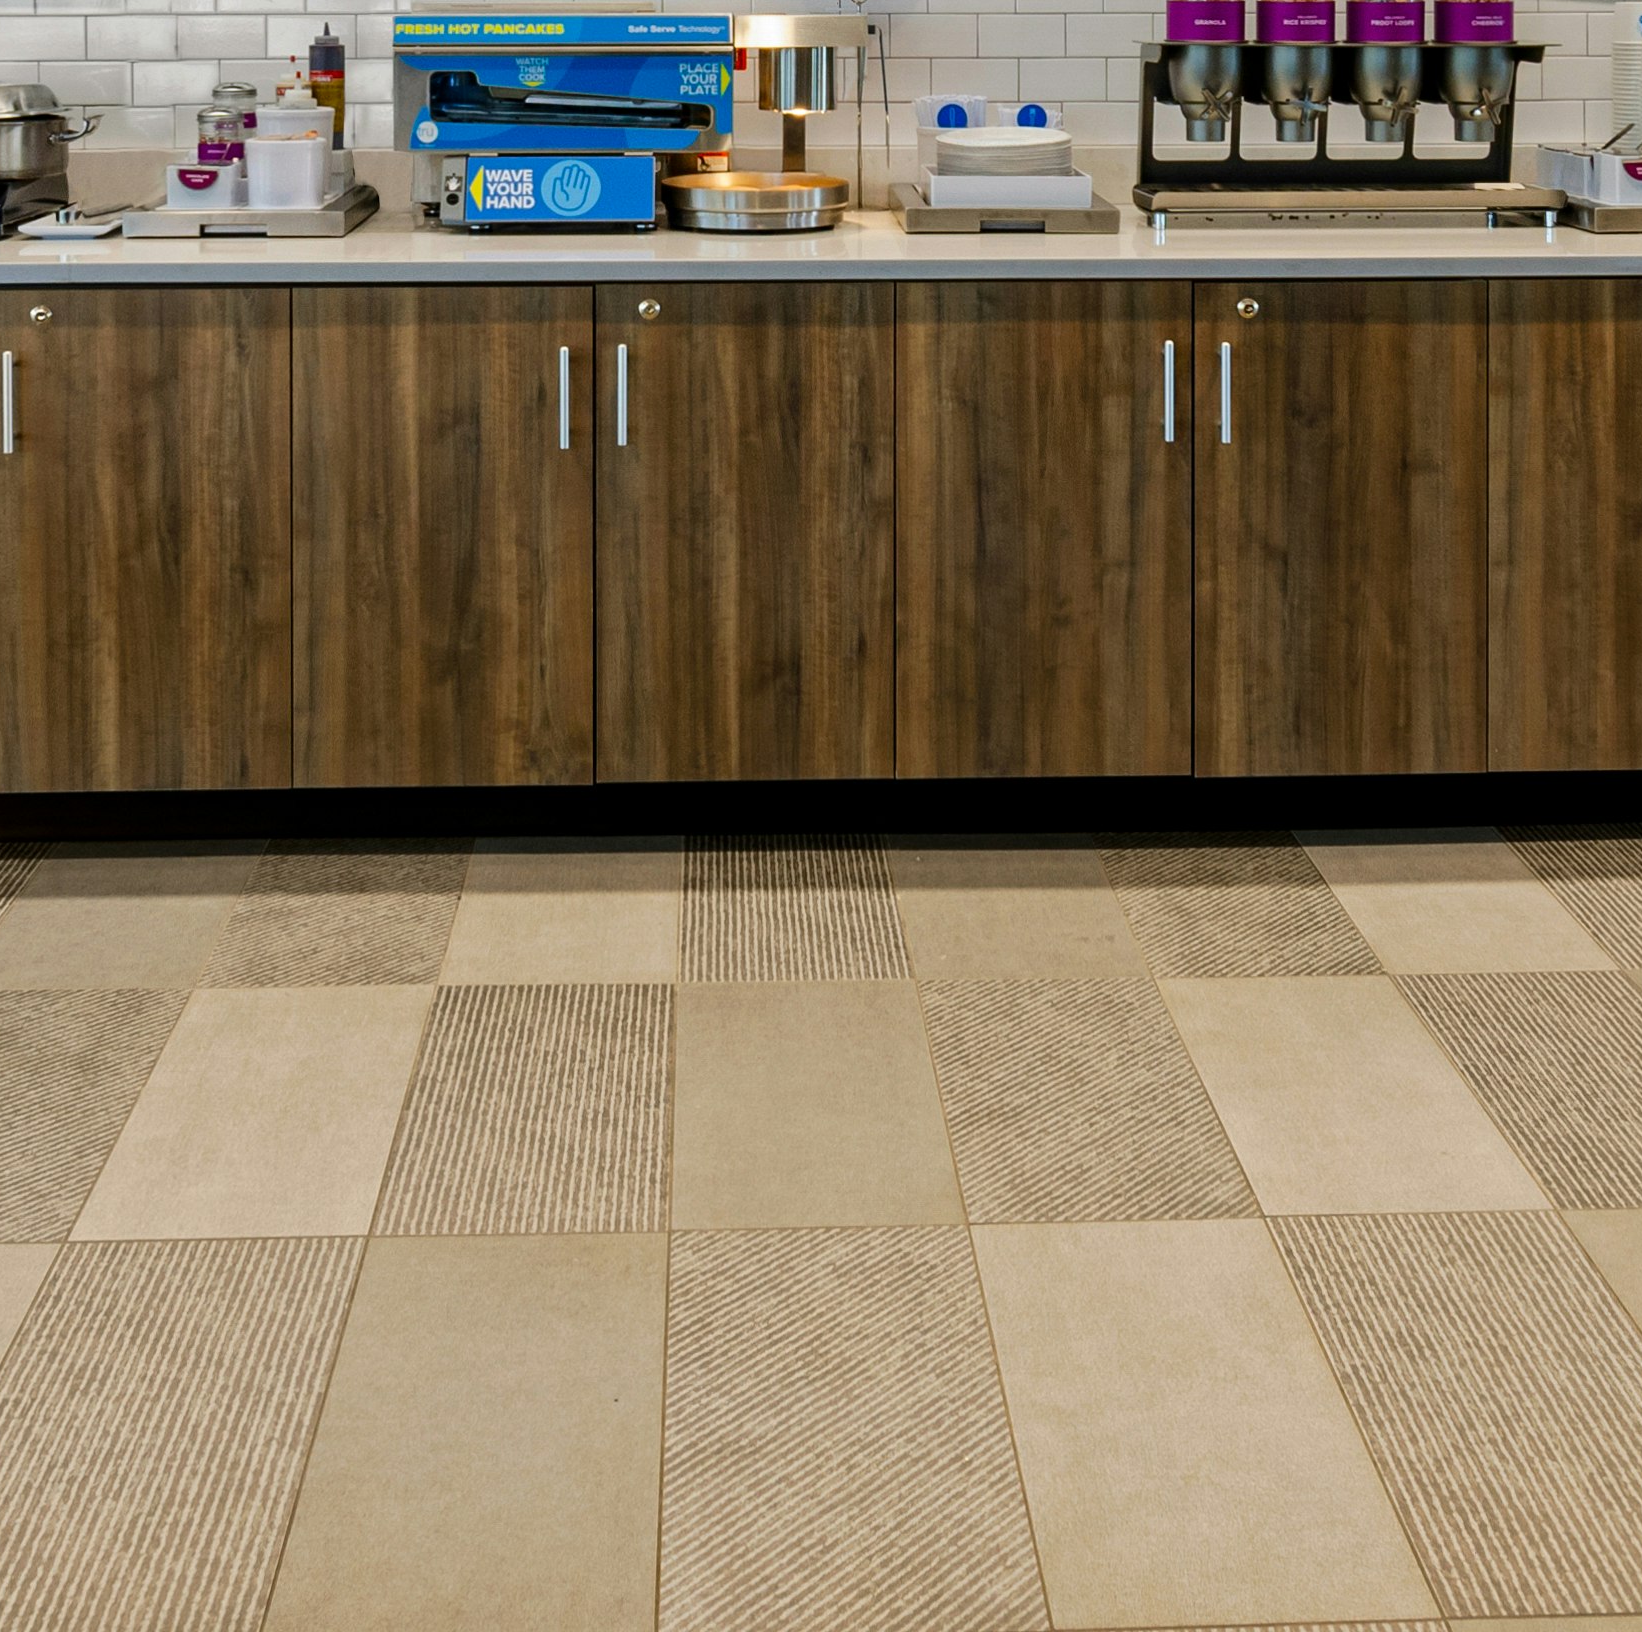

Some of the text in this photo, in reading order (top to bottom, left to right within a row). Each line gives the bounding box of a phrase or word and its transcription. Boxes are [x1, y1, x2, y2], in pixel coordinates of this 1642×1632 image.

[394, 23, 565, 35] FRESH HOT PANCAKES
[627, 25, 648, 33] Safe
[650, 25, 676, 33] Serve
[515, 57, 549, 66] WATCH
[679, 63, 718, 73] PLACE
[681, 74, 717, 84] YOUR
[680, 85, 718, 95] PLATE
[485, 169, 533, 182] WAVE
[486, 183, 534, 195] YOUR
[486, 196, 535, 209] HAND
